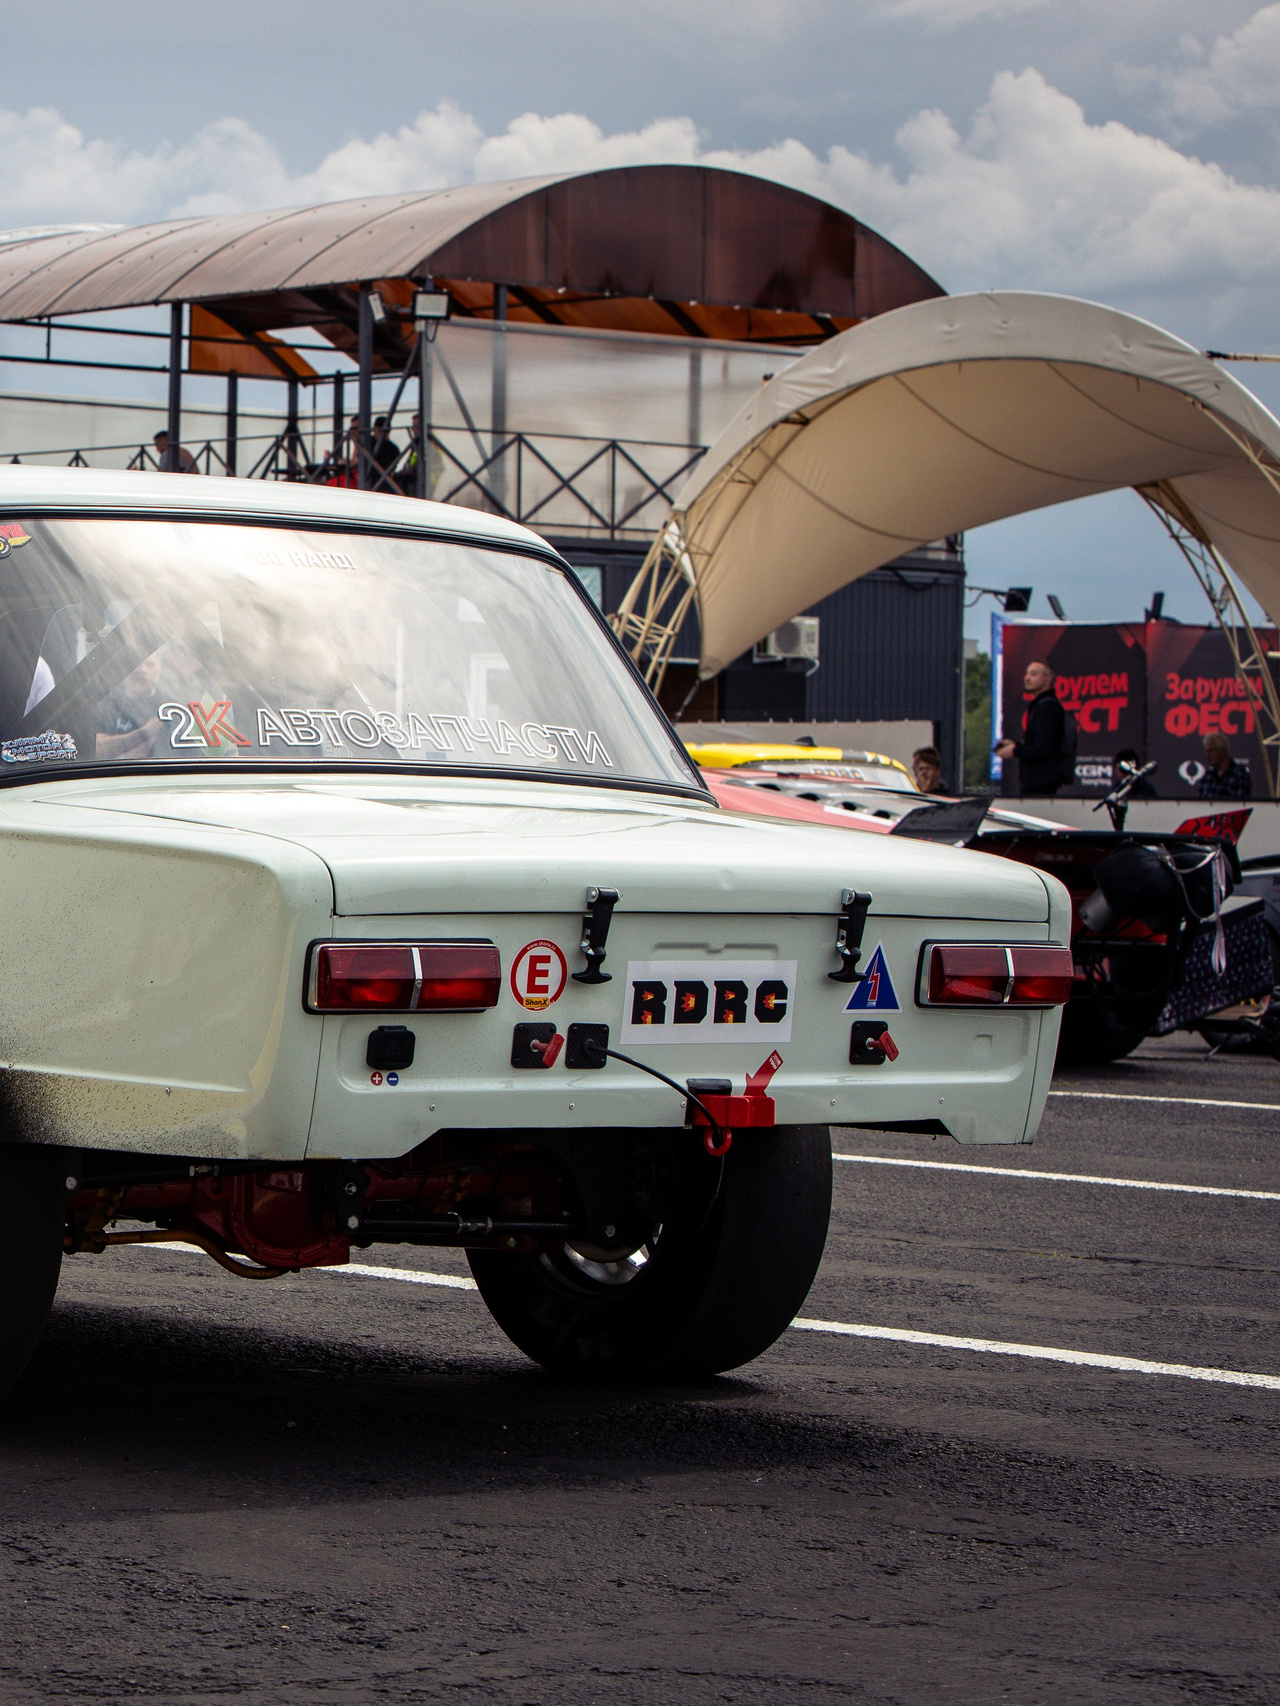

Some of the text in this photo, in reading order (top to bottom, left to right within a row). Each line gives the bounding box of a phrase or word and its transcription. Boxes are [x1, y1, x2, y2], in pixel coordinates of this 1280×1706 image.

[1165, 701, 1263, 737] ФЕСТ
[26, 749, 76, 761] SPORT
[257, 708, 614, 768] АВТОЗАПЧАСТИ
[526, 955, 551, 994] E
[525, 998, 548, 1006] ShonX
[631, 980, 788, 1025] RDRC
